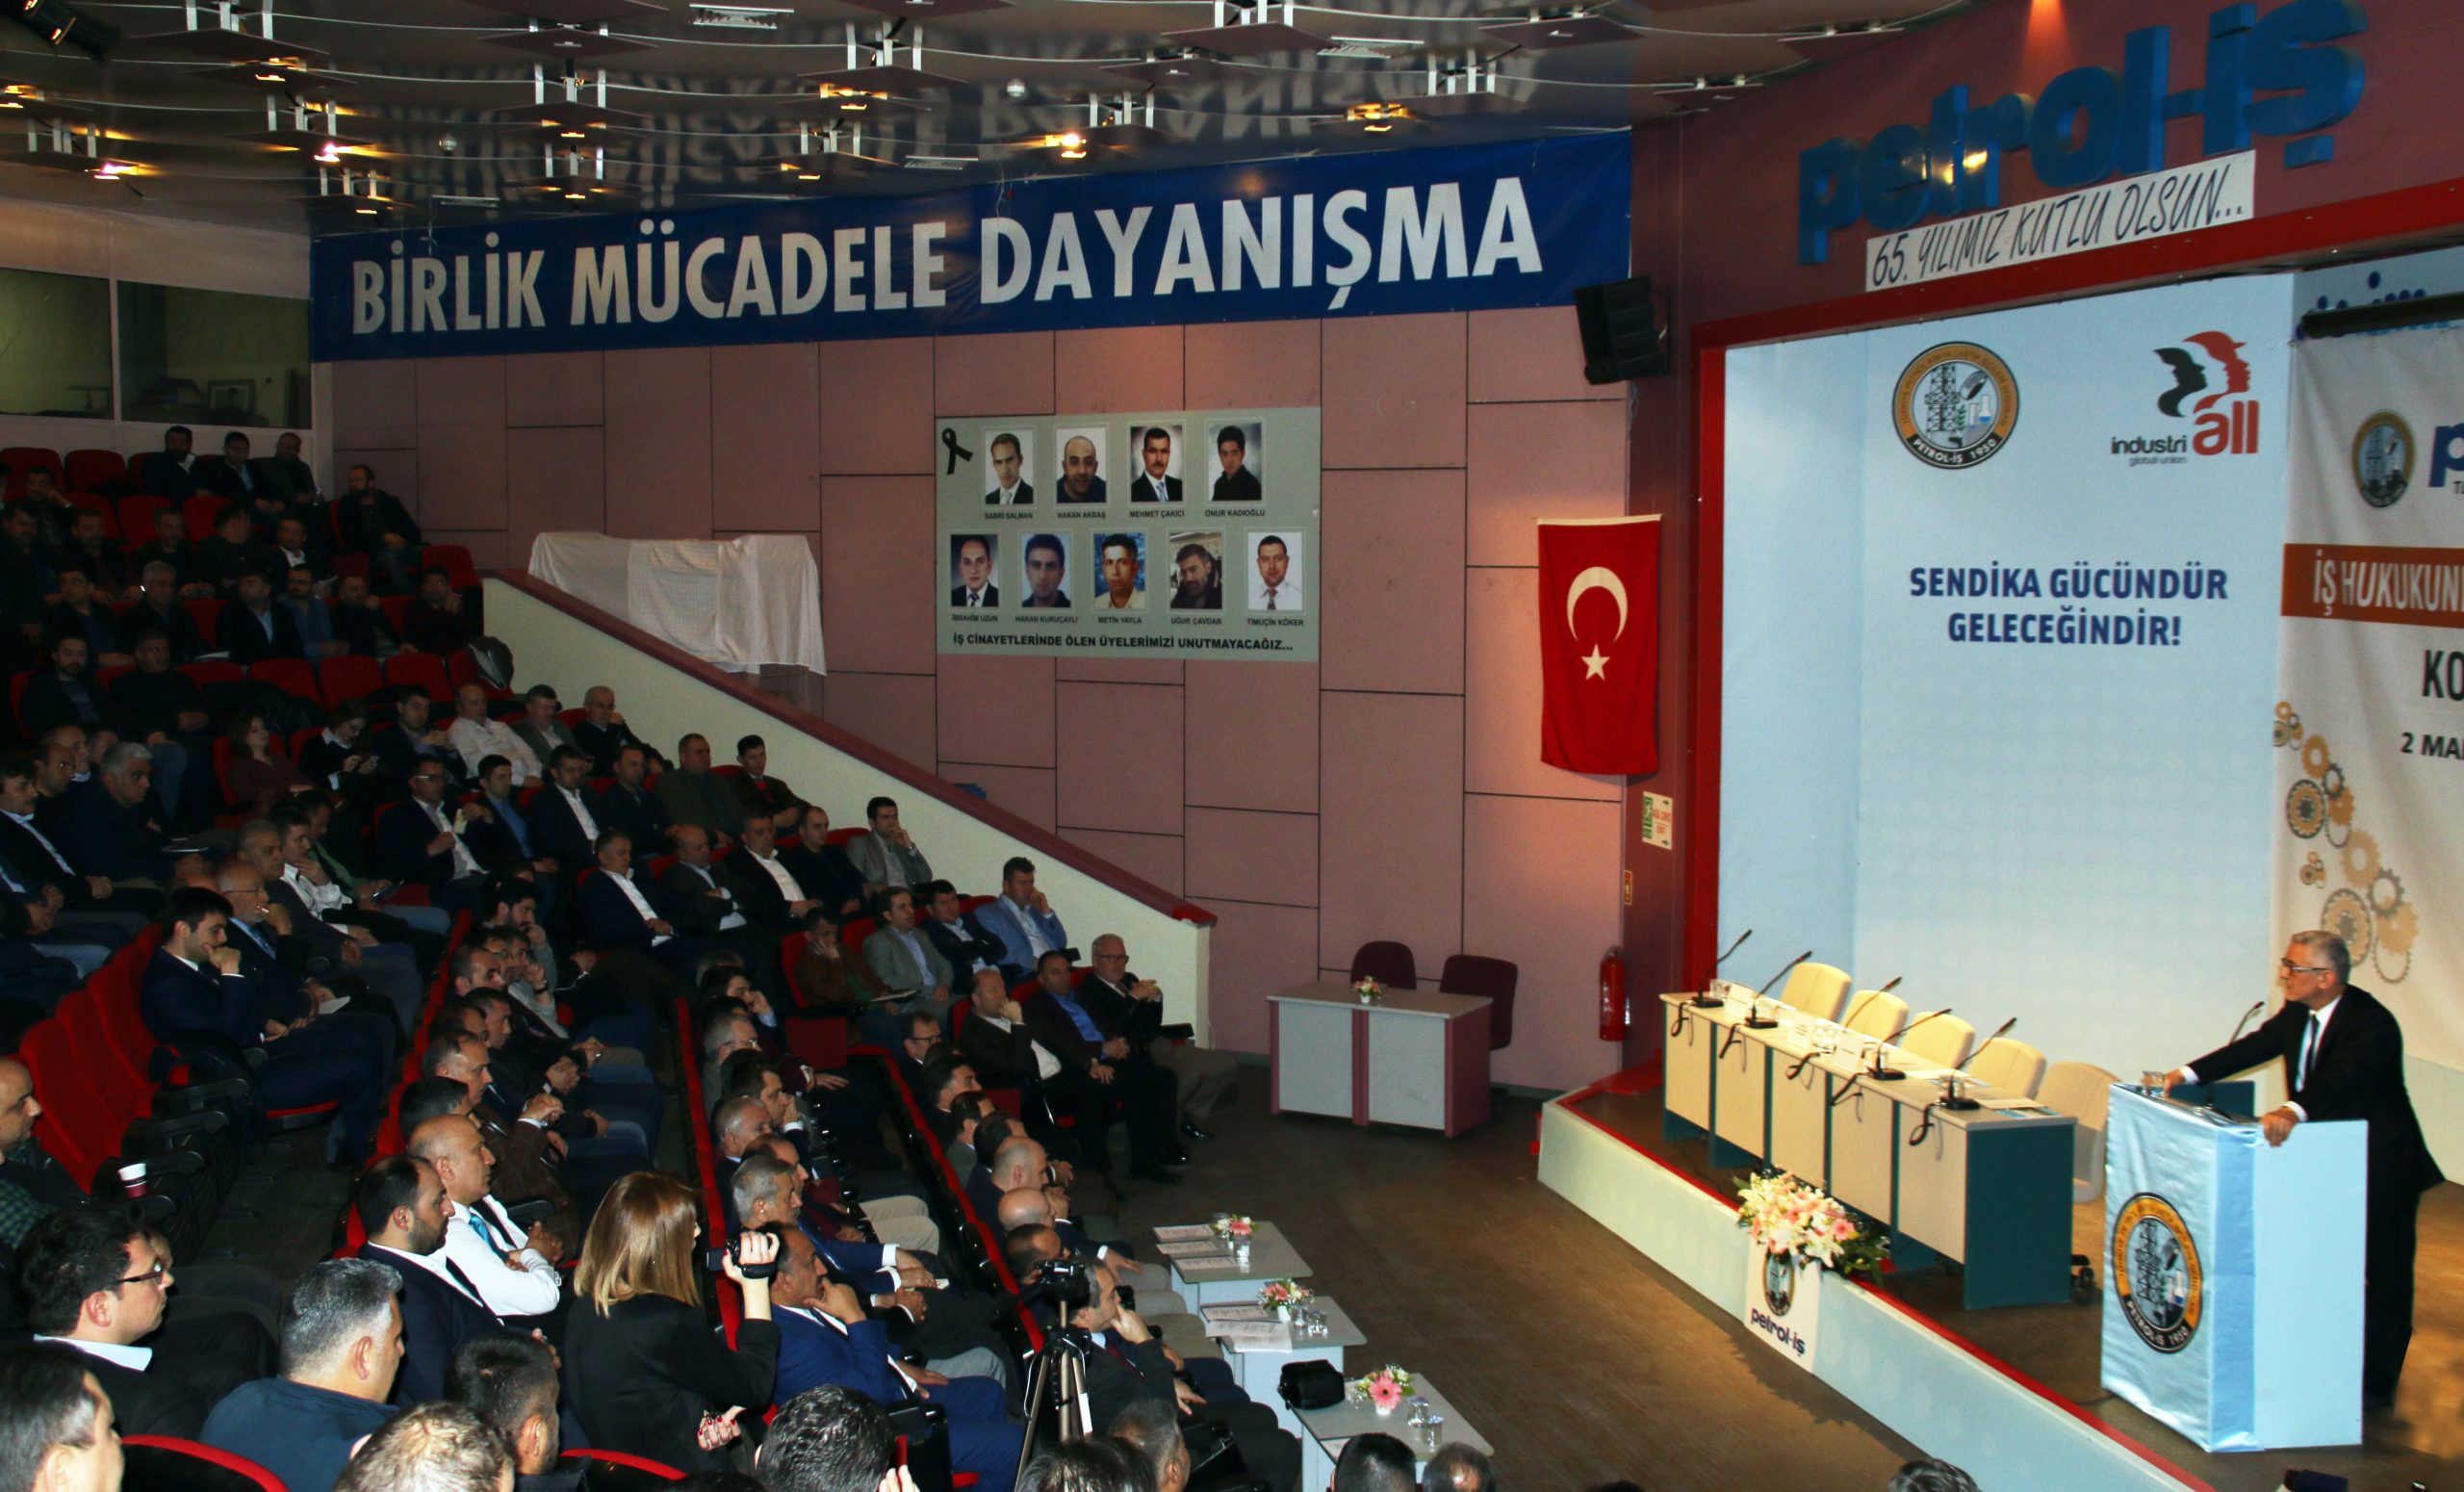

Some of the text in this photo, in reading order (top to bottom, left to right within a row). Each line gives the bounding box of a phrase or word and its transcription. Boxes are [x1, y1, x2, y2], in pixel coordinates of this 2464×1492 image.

[1872, 164, 2243, 287] 65. YILIMIZ KUTLU OLSUN...
[352, 176, 1543, 335] BİRLİK MÜCADELE DAYANIŞMA
[2111, 399, 2260, 455] industri all
[1969, 438, 1997, 459] 1950
[2129, 456, 2187, 467] global union
[1909, 559, 2228, 601] SENDİKA GÜCÜNDÜR
[2313, 549, 2464, 616] İŞ HUKUKUN
[1015, 615, 1039, 624] HAKAN
[1121, 616, 1142, 625] YAYLA
[1947, 605, 2181, 646] GELECEĞİNDİR!
[953, 631, 964, 646] İŞ
[967, 632, 1062, 646] CİNAYETLERİNDE
[1065, 633, 1096, 647] ÖLEN
[1099, 634, 1174, 649] ÜYELERİMİZİ
[2400, 732, 2464, 760] 2 MA
